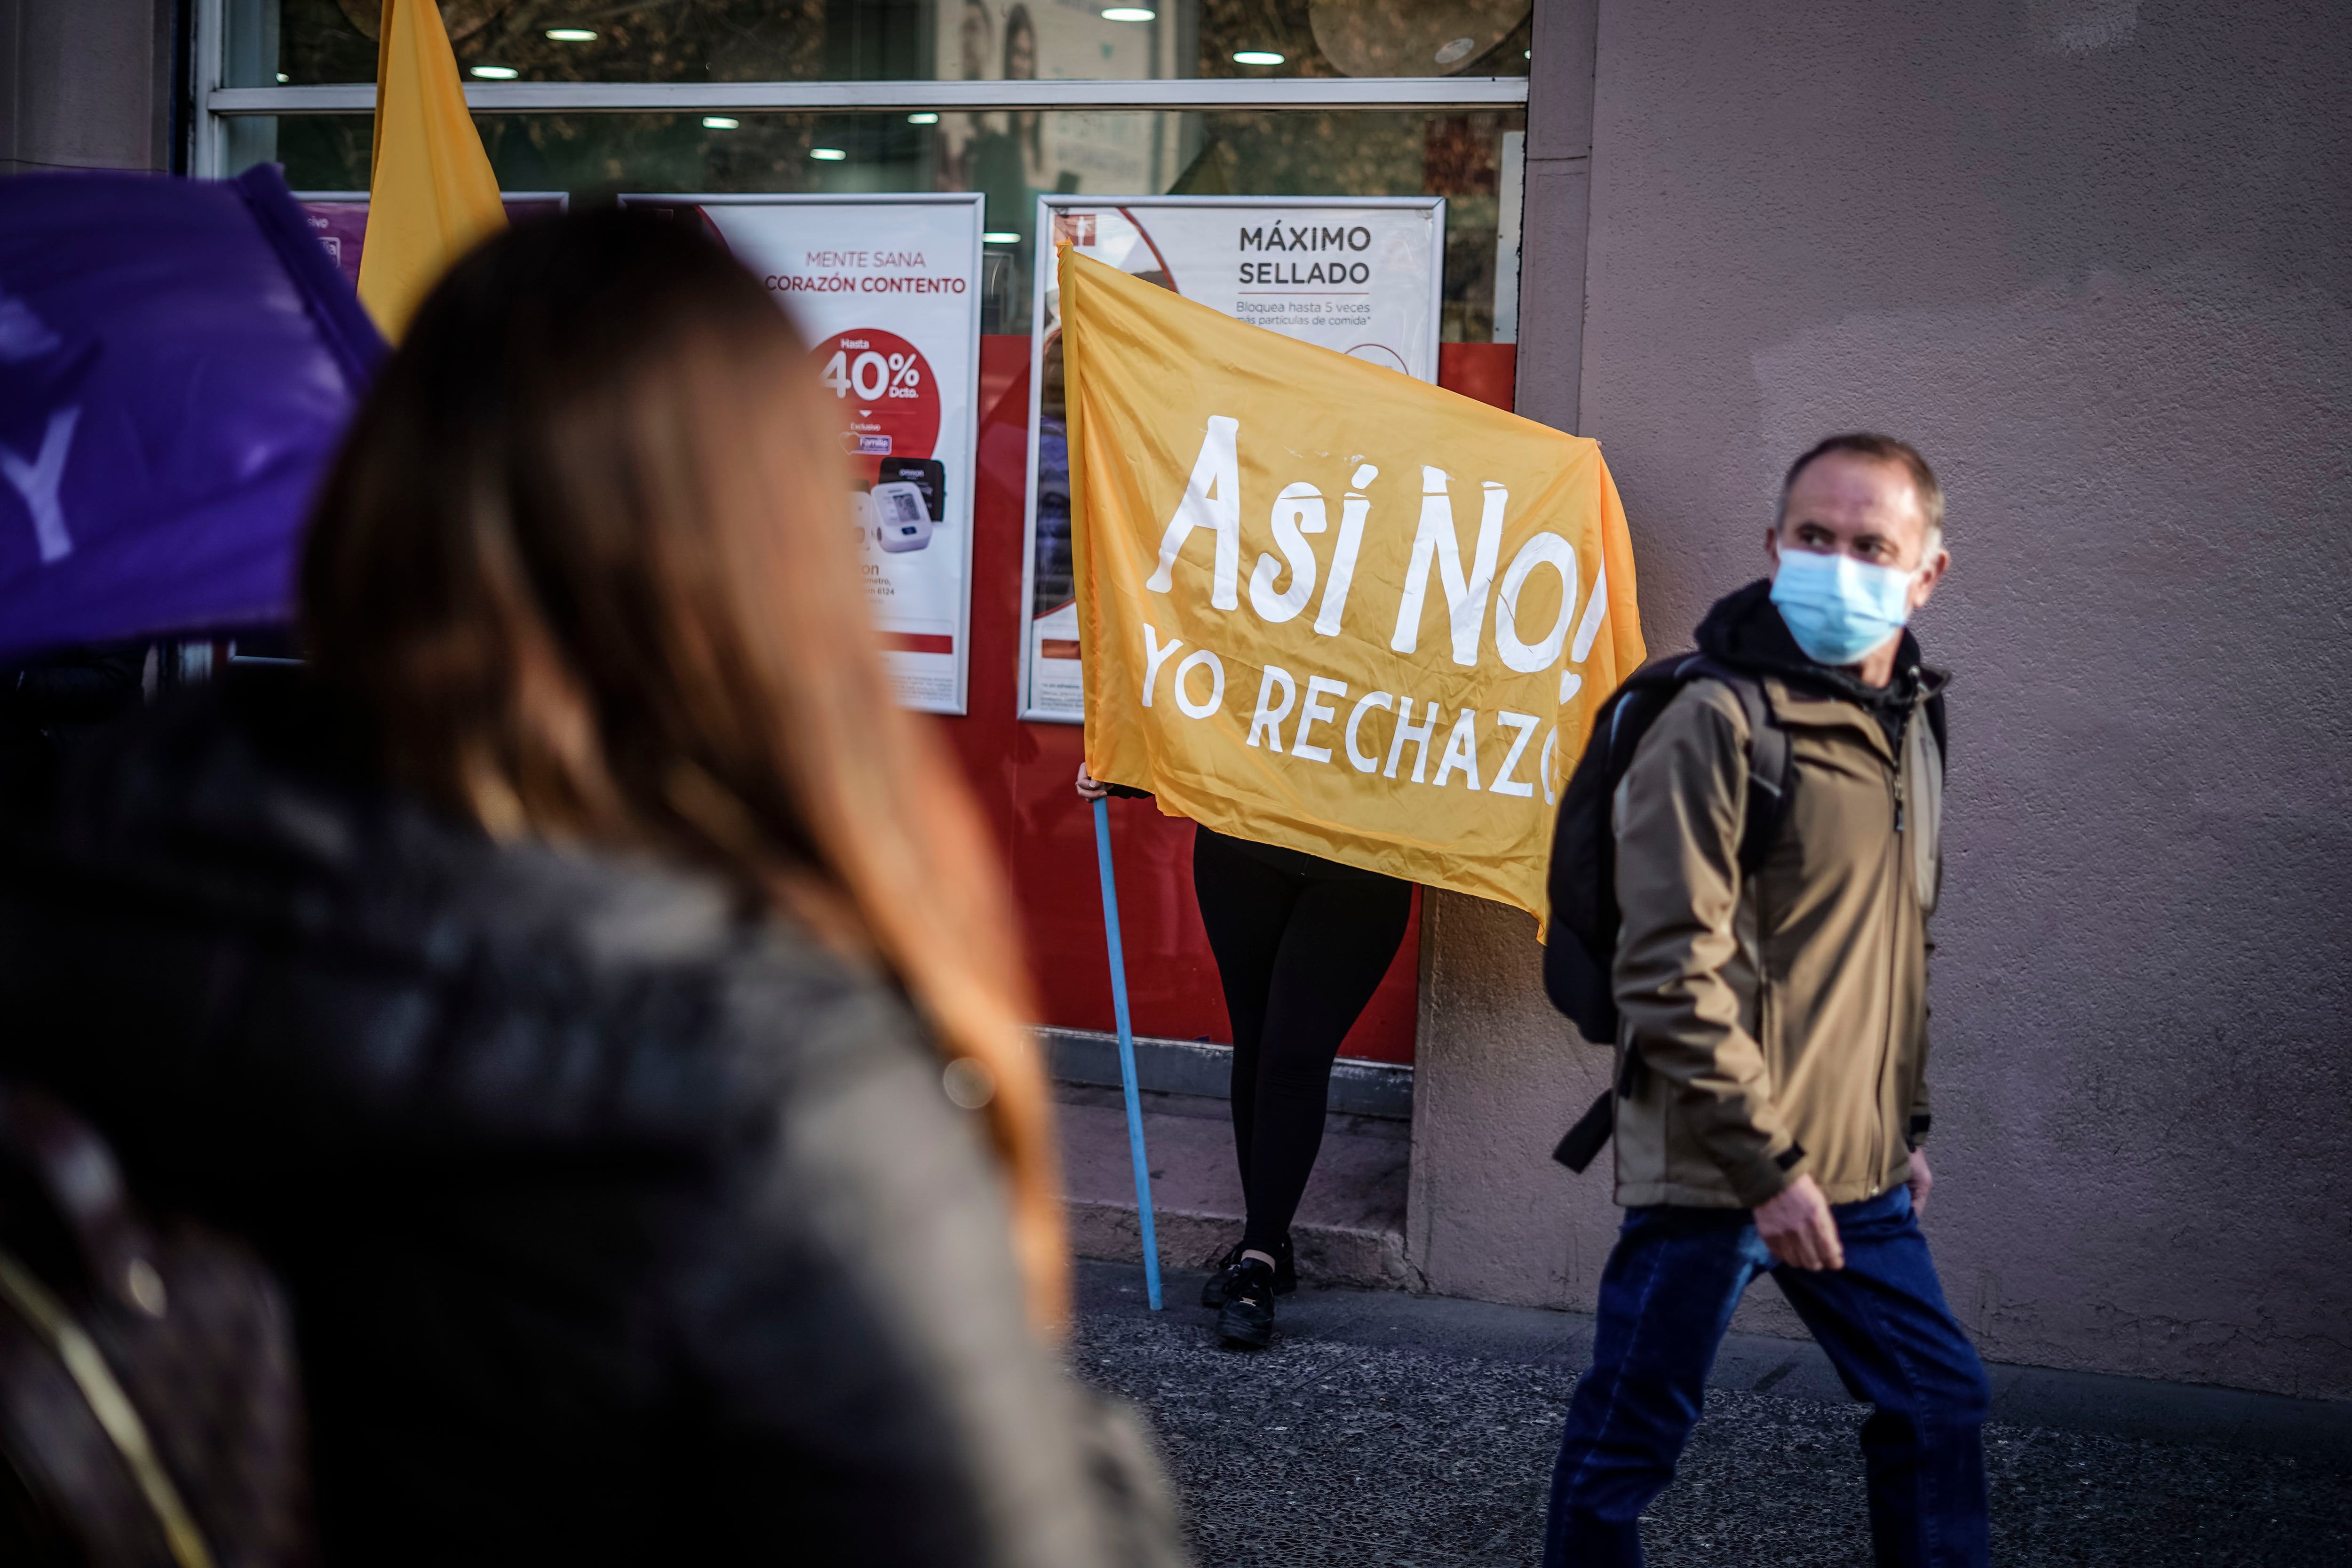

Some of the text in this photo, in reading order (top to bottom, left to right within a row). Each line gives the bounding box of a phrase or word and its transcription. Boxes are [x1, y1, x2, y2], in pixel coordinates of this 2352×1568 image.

[1240, 219, 1371, 251] MÁXIMO
[805, 251, 926, 268] MENTE SANA
[1239, 262, 1370, 284] SELLADO
[764, 272, 966, 294] CORAZÓN CONTENTO
[1236, 302, 1285, 313] Bloquea
[1288, 302, 1320, 312] hasta
[1325, 302, 1332, 312] 5
[1259, 315, 1309, 327] partículas
[1311, 317, 1325, 325] de
[841, 338, 870, 349] Hasta
[820, 350, 920, 401] 40%
[889, 386, 919, 398] Dcto.
[1141, 622, 1225, 720] YO
